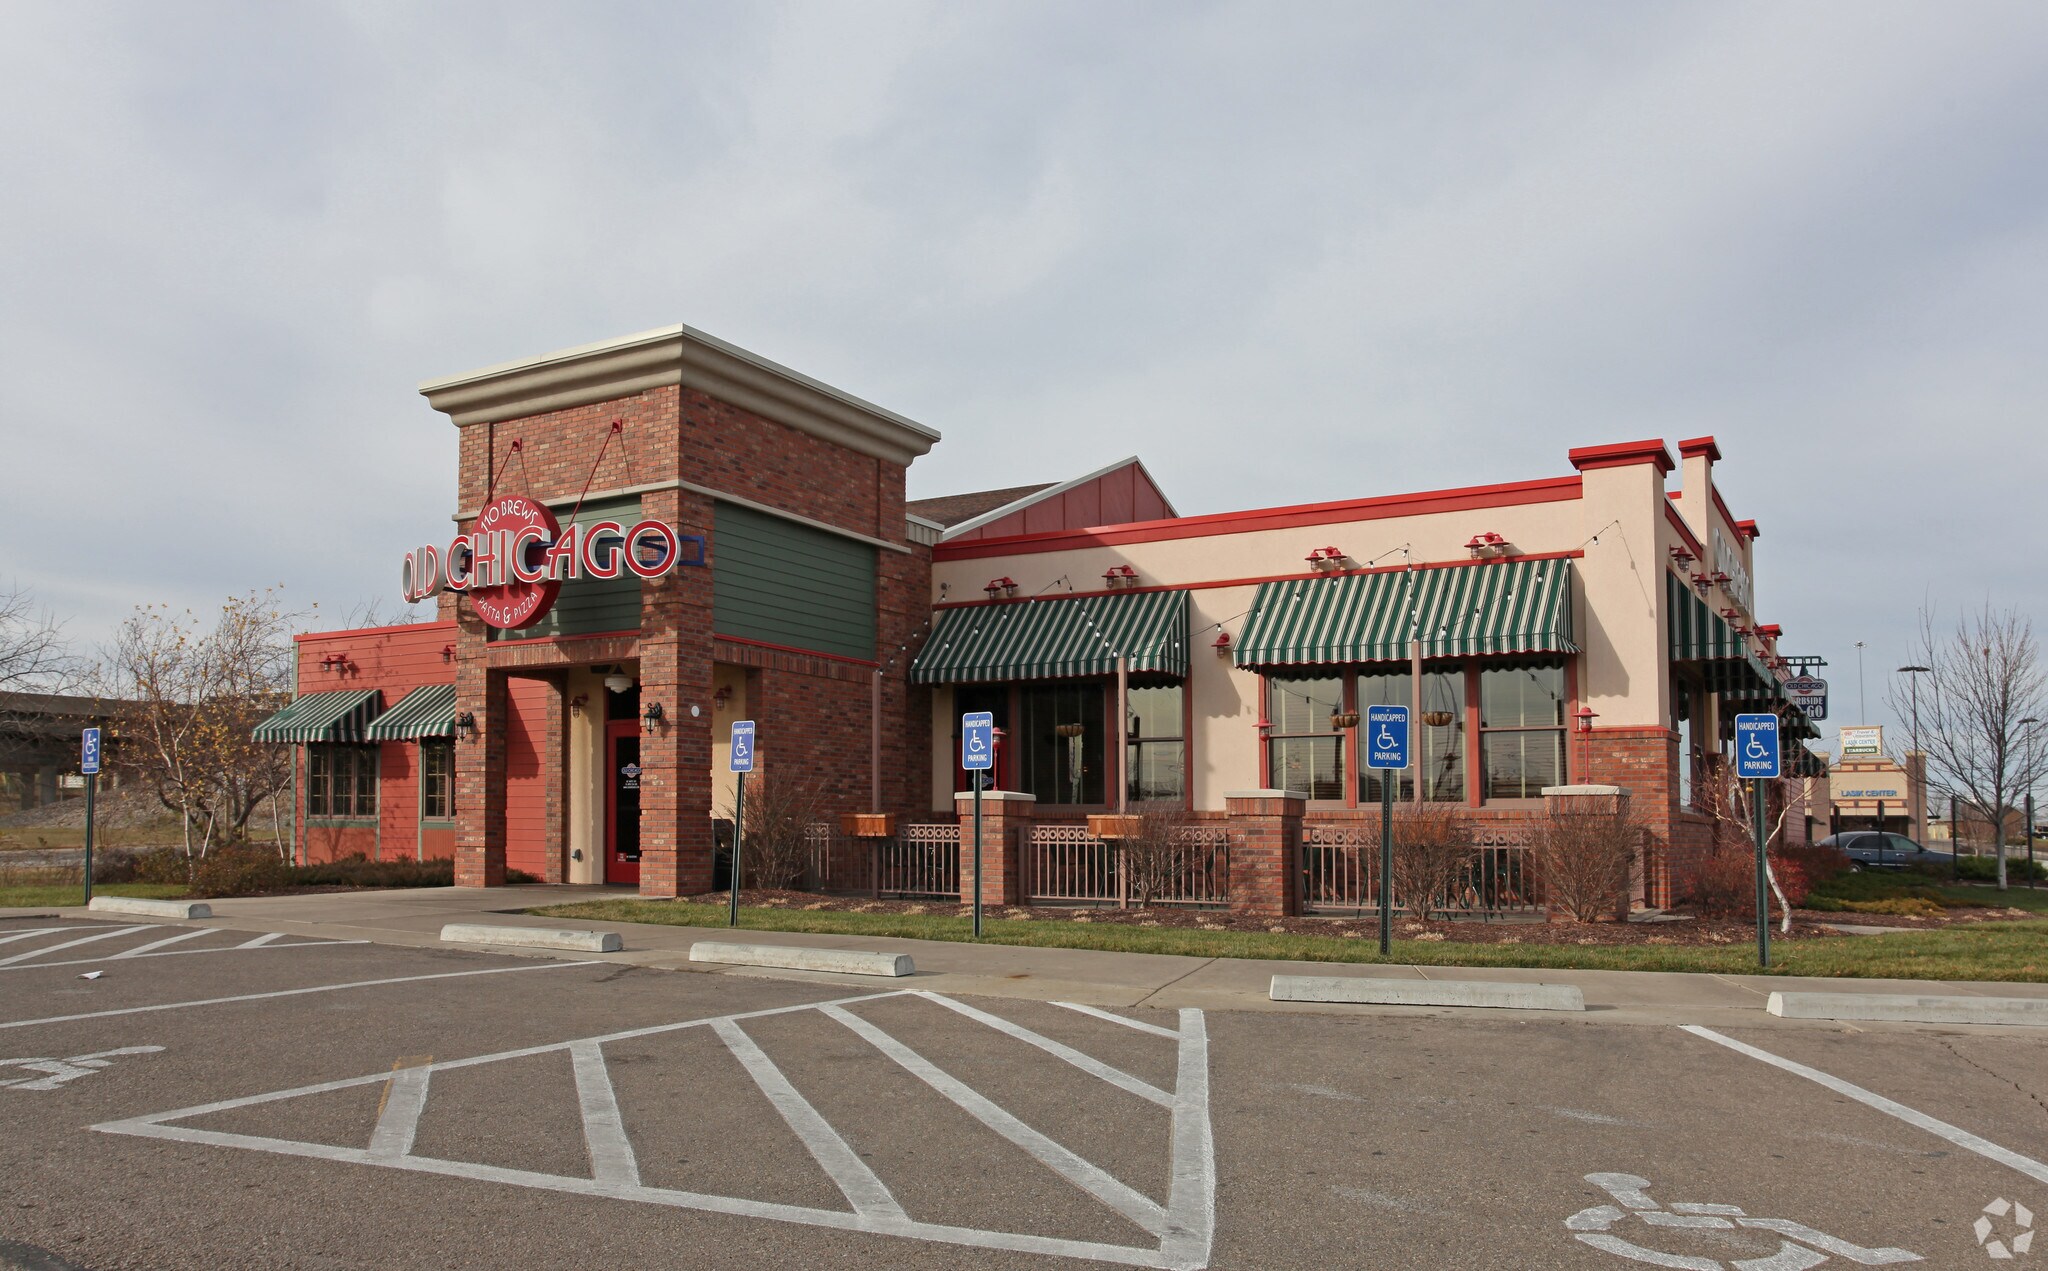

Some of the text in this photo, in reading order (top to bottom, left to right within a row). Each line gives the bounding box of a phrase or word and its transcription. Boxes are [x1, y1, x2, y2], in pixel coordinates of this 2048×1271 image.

[481, 500, 538, 531] 110 BREWS
[402, 519, 679, 603] OLD CHICAGO
[478, 592, 538, 624] PASTA & PIZZA
[1796, 697, 1823, 705] RBSIDE
[1371, 713, 1406, 722] HANDICAPPED
[965, 720, 990, 728] HANDICAPPED
[1739, 722, 1775, 730] HANDICAPPED
[967, 754, 987, 762] PARKING
[1374, 752, 1401, 761] PARKING
[1744, 761, 1772, 769] PARKING
